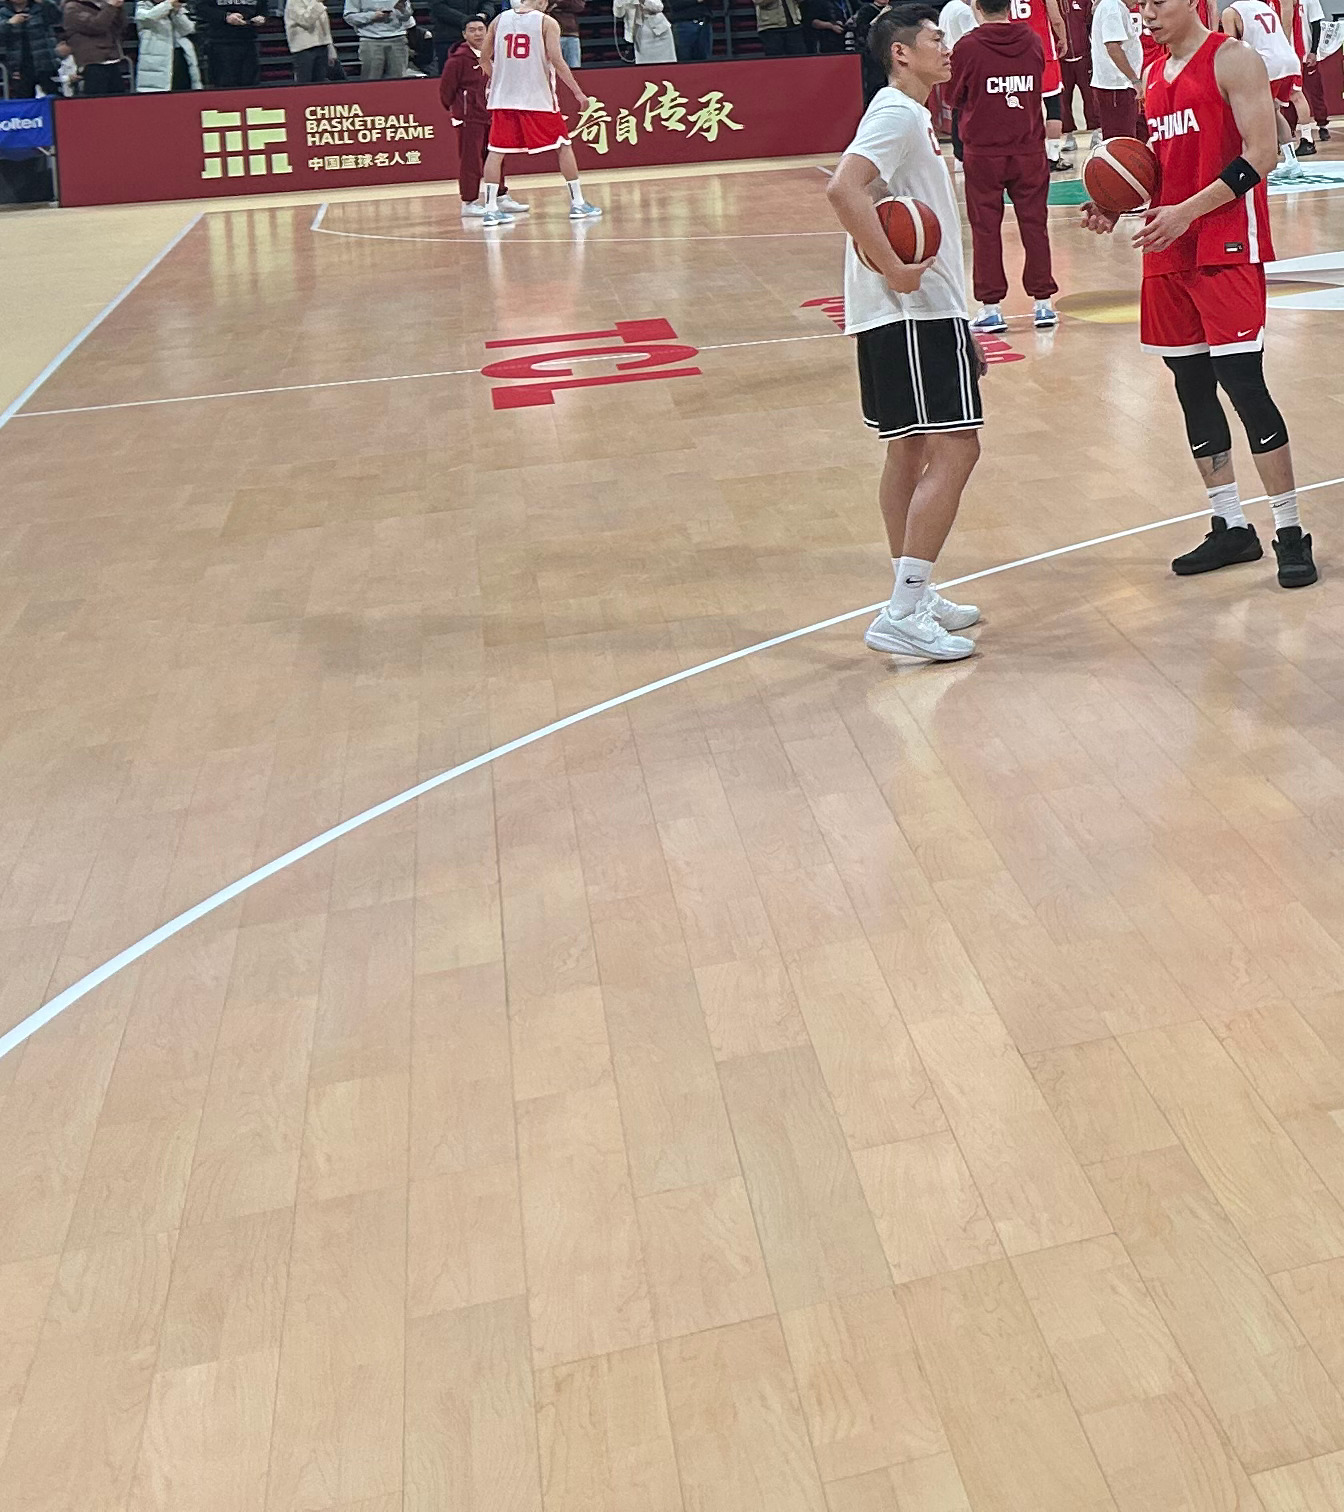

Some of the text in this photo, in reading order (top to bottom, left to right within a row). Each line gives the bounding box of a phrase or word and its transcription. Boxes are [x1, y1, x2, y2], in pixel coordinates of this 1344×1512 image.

[1254, 13, 1276, 34] 17
[504, 34, 530, 59] 18
[987, 75, 1034, 94] CHINA
[305, 104, 362, 119] CHINA
[568, 81, 745, 155] 奇自传承
[306, 113, 419, 133] BASKETBALL
[306, 124, 434, 147] HALL OF FAME
[308, 150, 421, 172] 中国篮球名人堂
